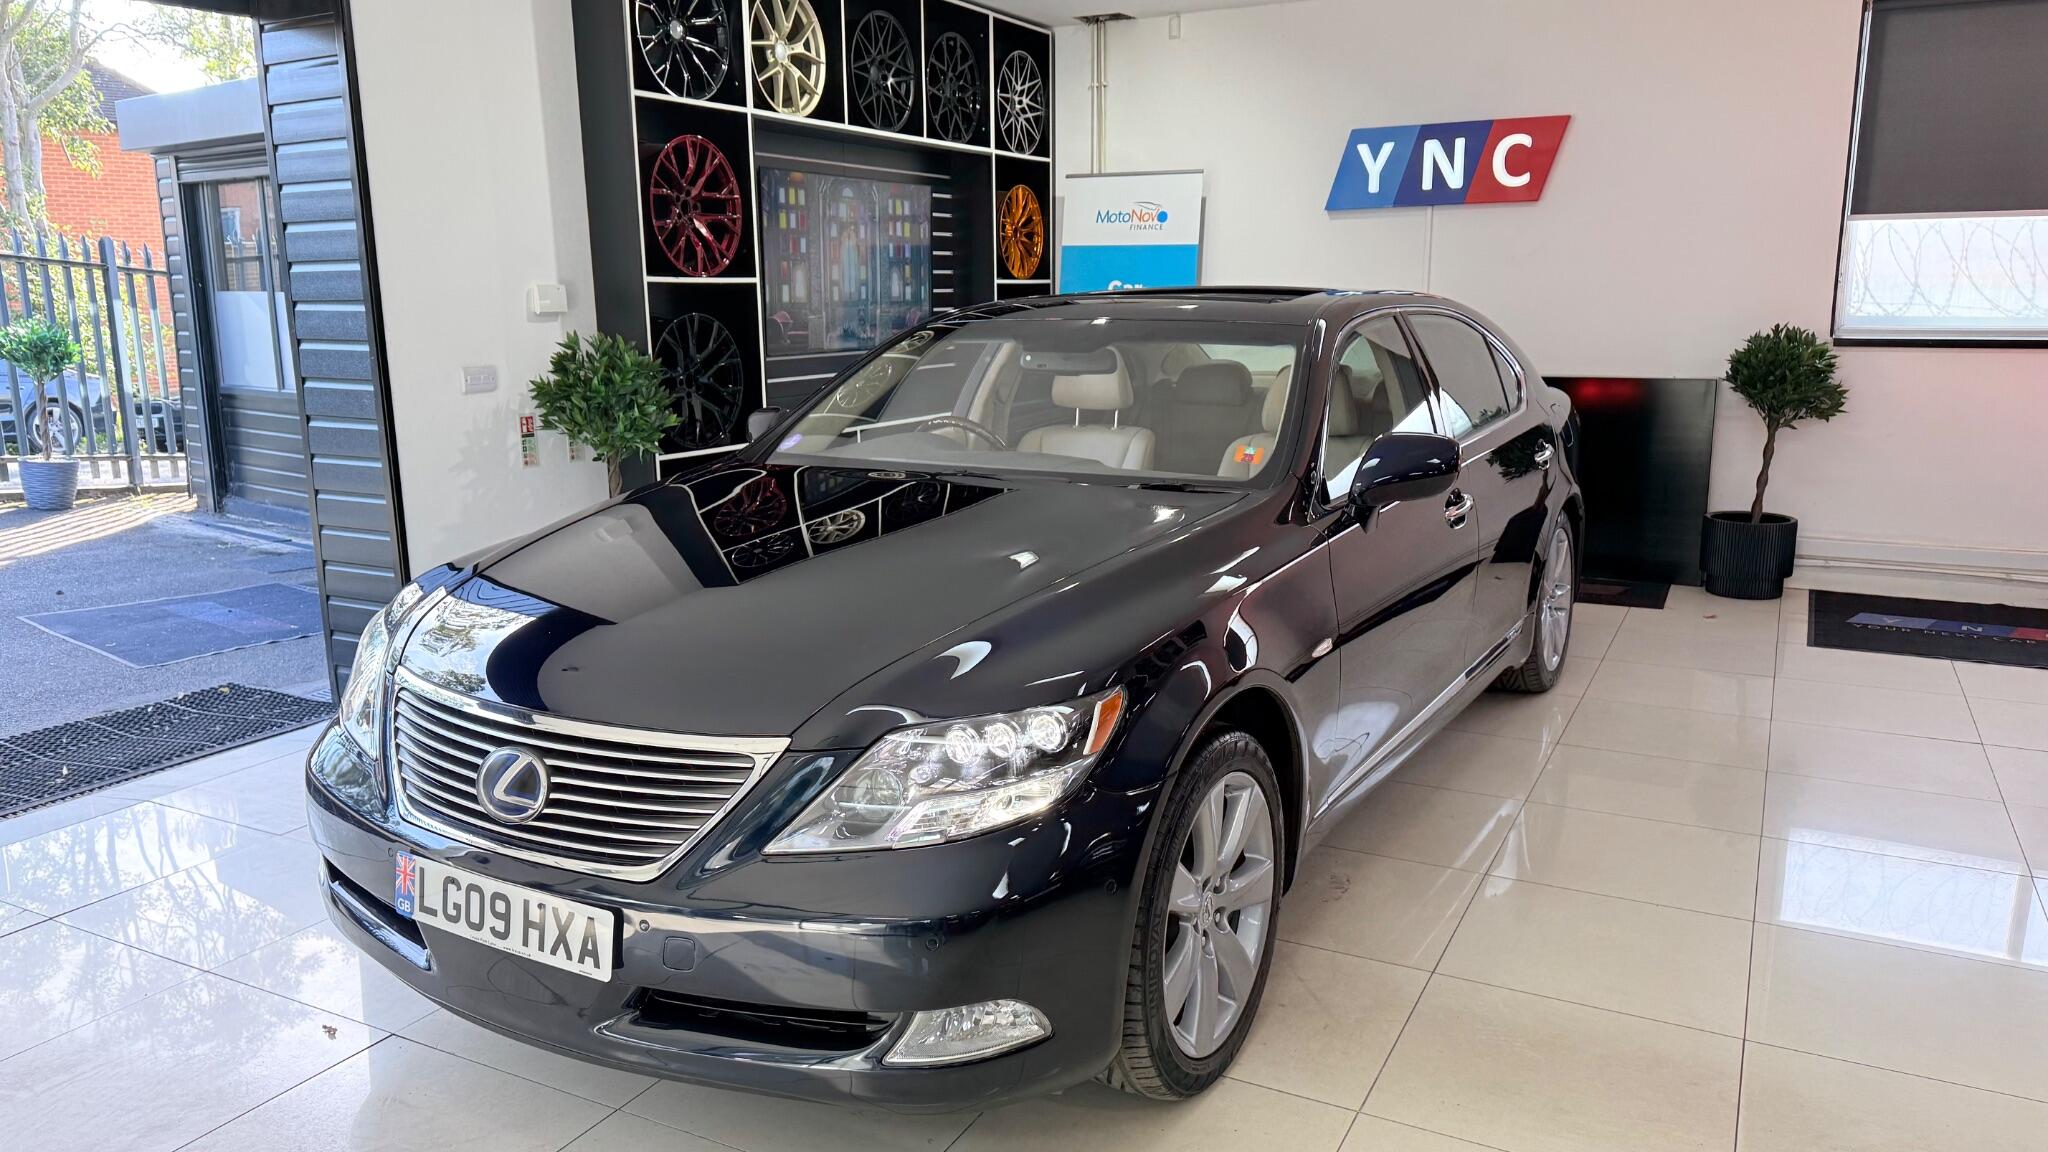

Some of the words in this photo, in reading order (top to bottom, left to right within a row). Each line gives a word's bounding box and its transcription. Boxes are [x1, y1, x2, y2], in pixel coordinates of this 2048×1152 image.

[1356, 133, 1533, 194] YNC
[1129, 223, 1164, 231] FINANCE
[397, 897, 412, 913] GB
[418, 866, 512, 941] LG09
[522, 898, 601, 970] HXA
[1149, 907, 1163, 1018] UNIROYAL
